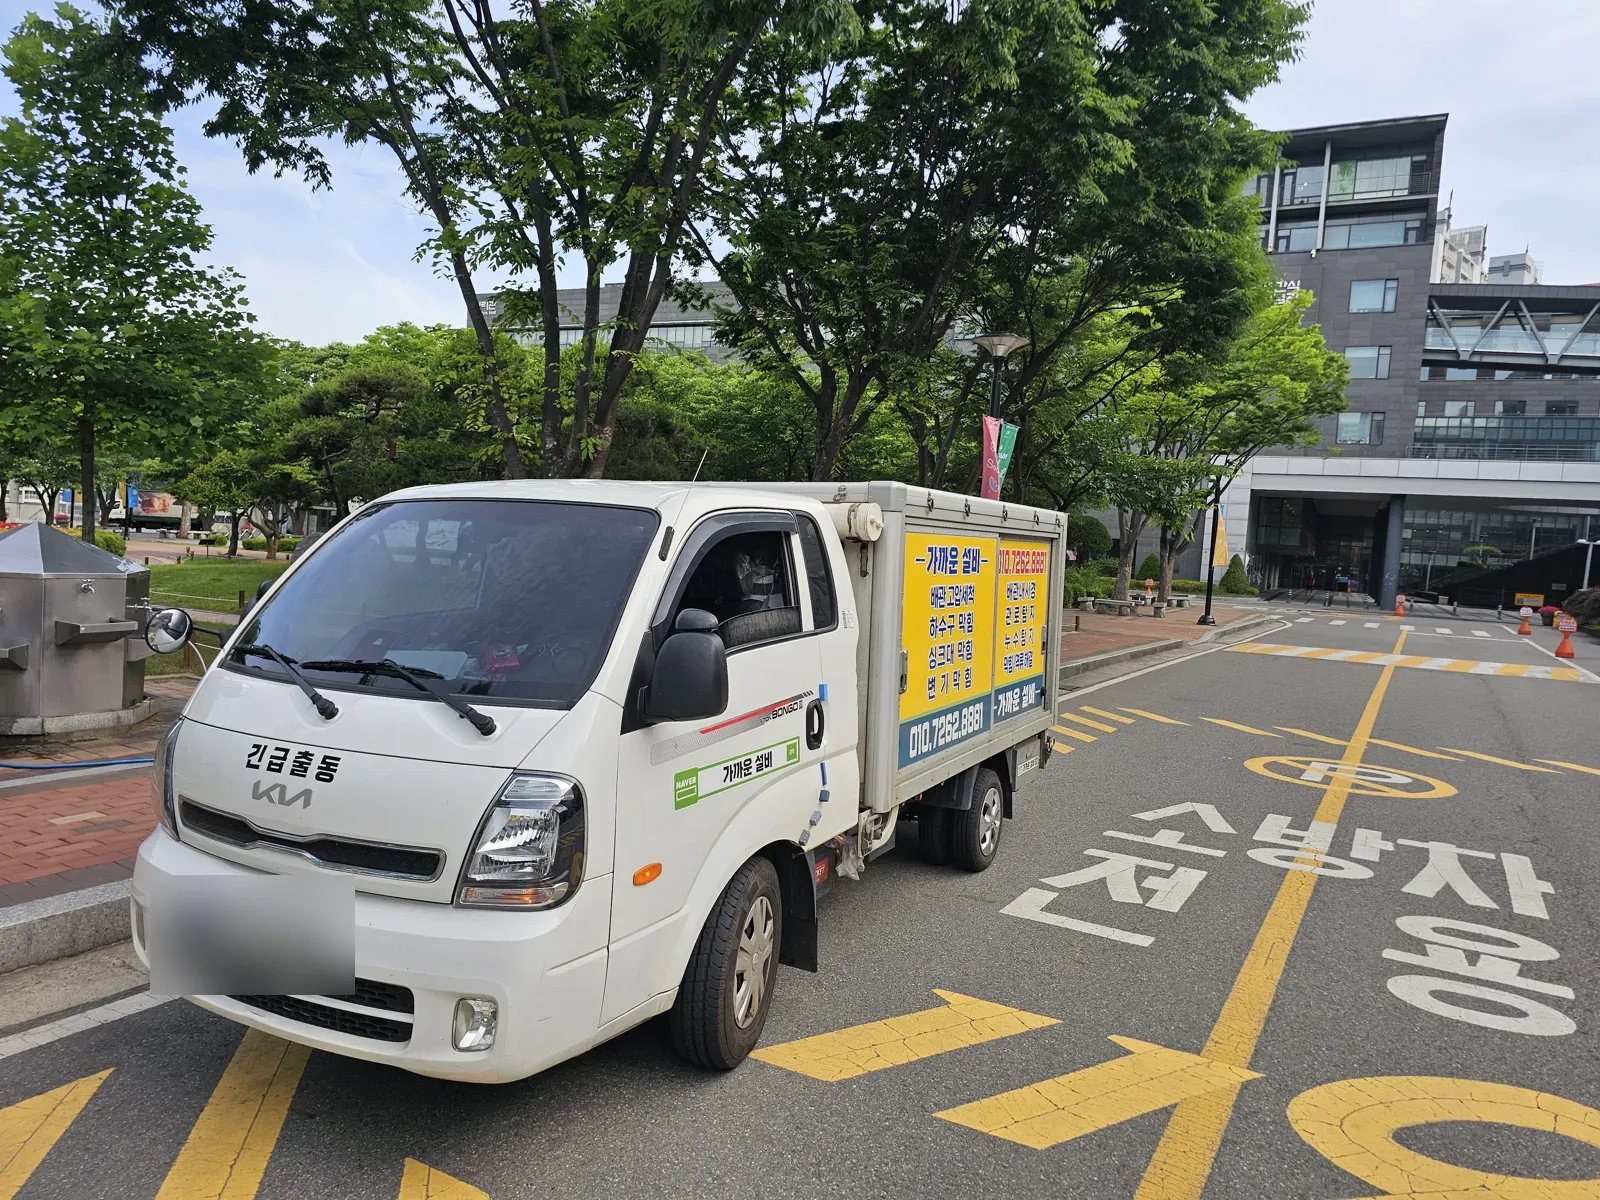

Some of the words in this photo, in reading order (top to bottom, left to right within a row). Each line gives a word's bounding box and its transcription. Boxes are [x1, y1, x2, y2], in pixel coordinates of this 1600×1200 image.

[930, 585, 946, 610] 배관
[946, 583, 975, 607] 고압세척
[929, 614, 955, 639] 하수구
[958, 611, 974, 634] 막힘
[928, 643, 955, 670] 싱크대
[957, 639, 973, 664] 막힘
[771, 701, 799, 720] BONGO
[909, 702, 984, 759] 010.7262.8881
[245, 743, 342, 784] 긴급출동
[722, 757, 753, 784] 가까운
[755, 750, 773, 773] 설비
[675, 776, 697, 790] NAVER
